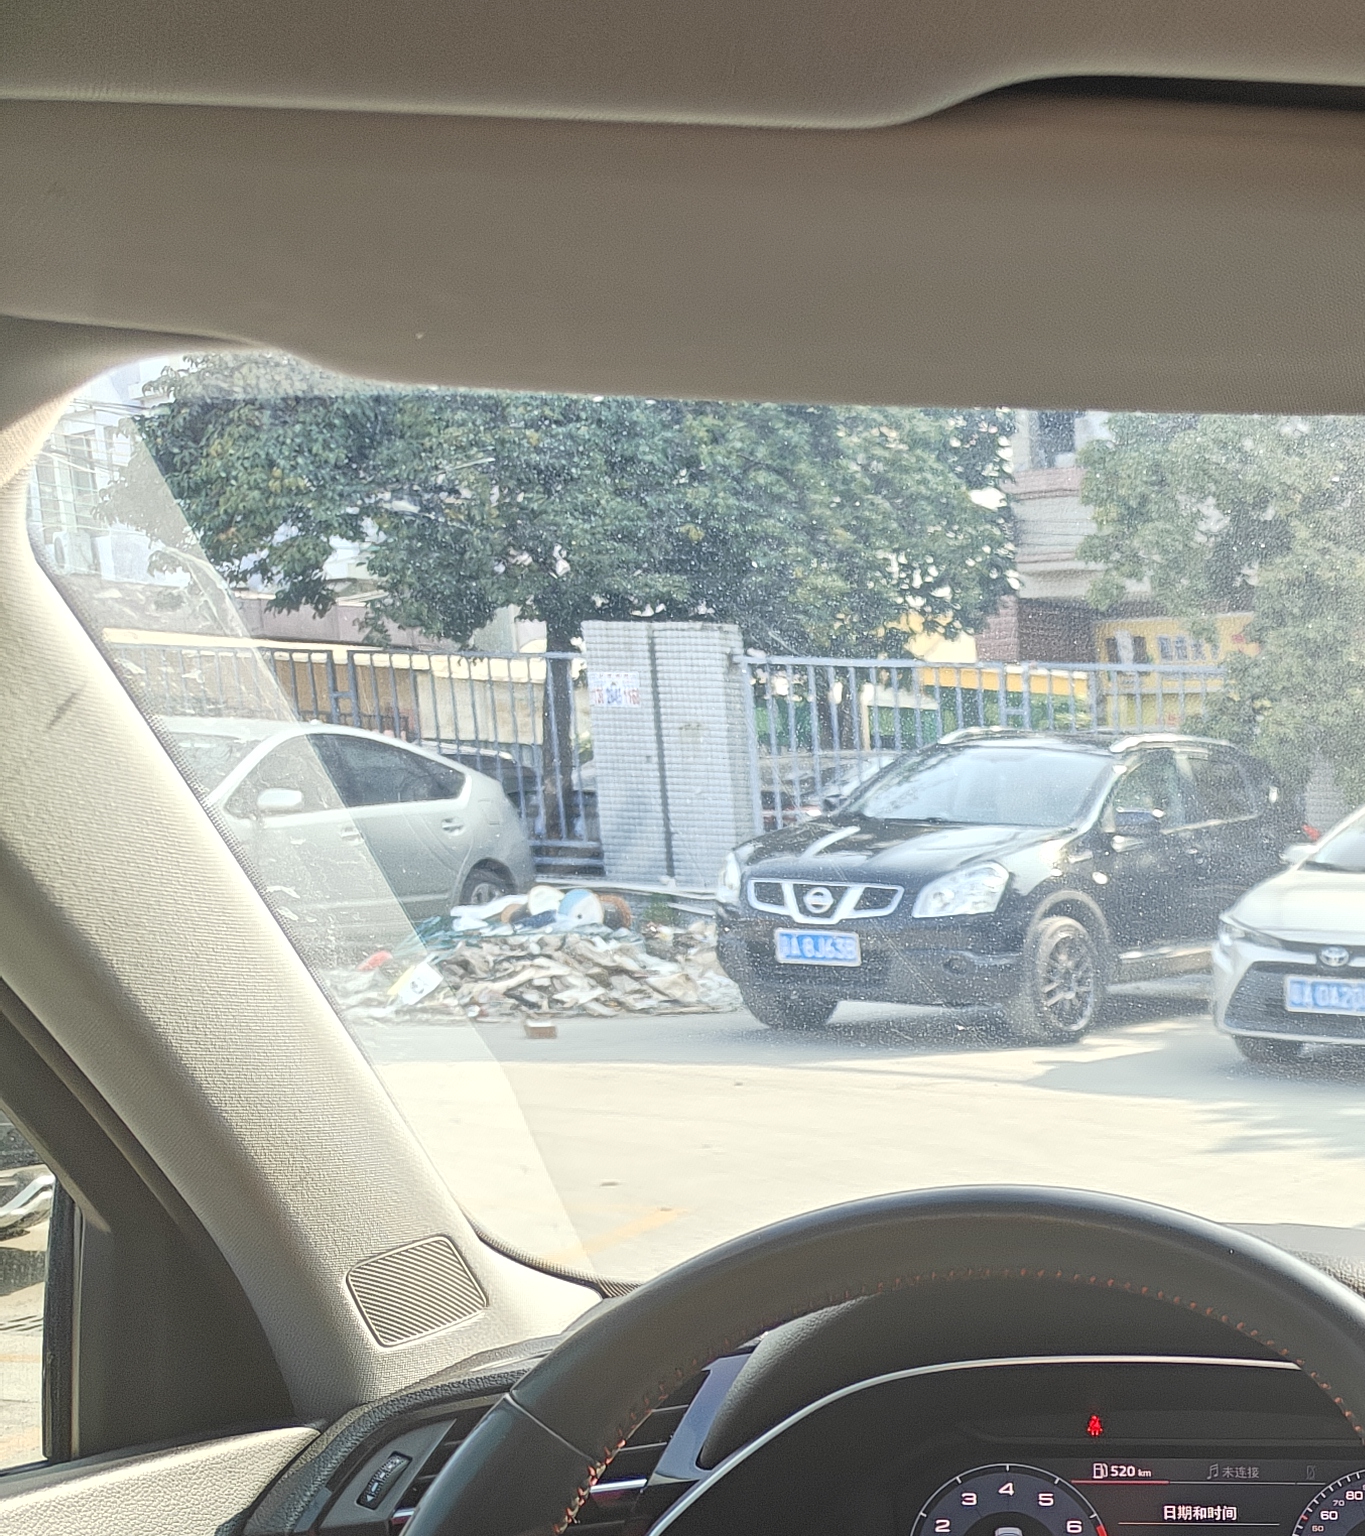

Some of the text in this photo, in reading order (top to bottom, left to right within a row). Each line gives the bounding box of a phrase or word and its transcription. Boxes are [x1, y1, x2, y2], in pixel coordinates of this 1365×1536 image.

[1110, 1465, 1152, 1478] 520 km
[1222, 1466, 1260, 1479] 未连接
[998, 1483, 1015, 1496] 4
[1345, 1490, 1363, 1500] 80
[961, 1492, 977, 1506] 3
[1037, 1493, 1054, 1506] 5
[1163, 1505, 1237, 1520] 日期和时间
[1320, 1510, 1338, 1520] 60
[935, 1519, 951, 1533] 2
[1066, 1520, 1083, 1534] 6
